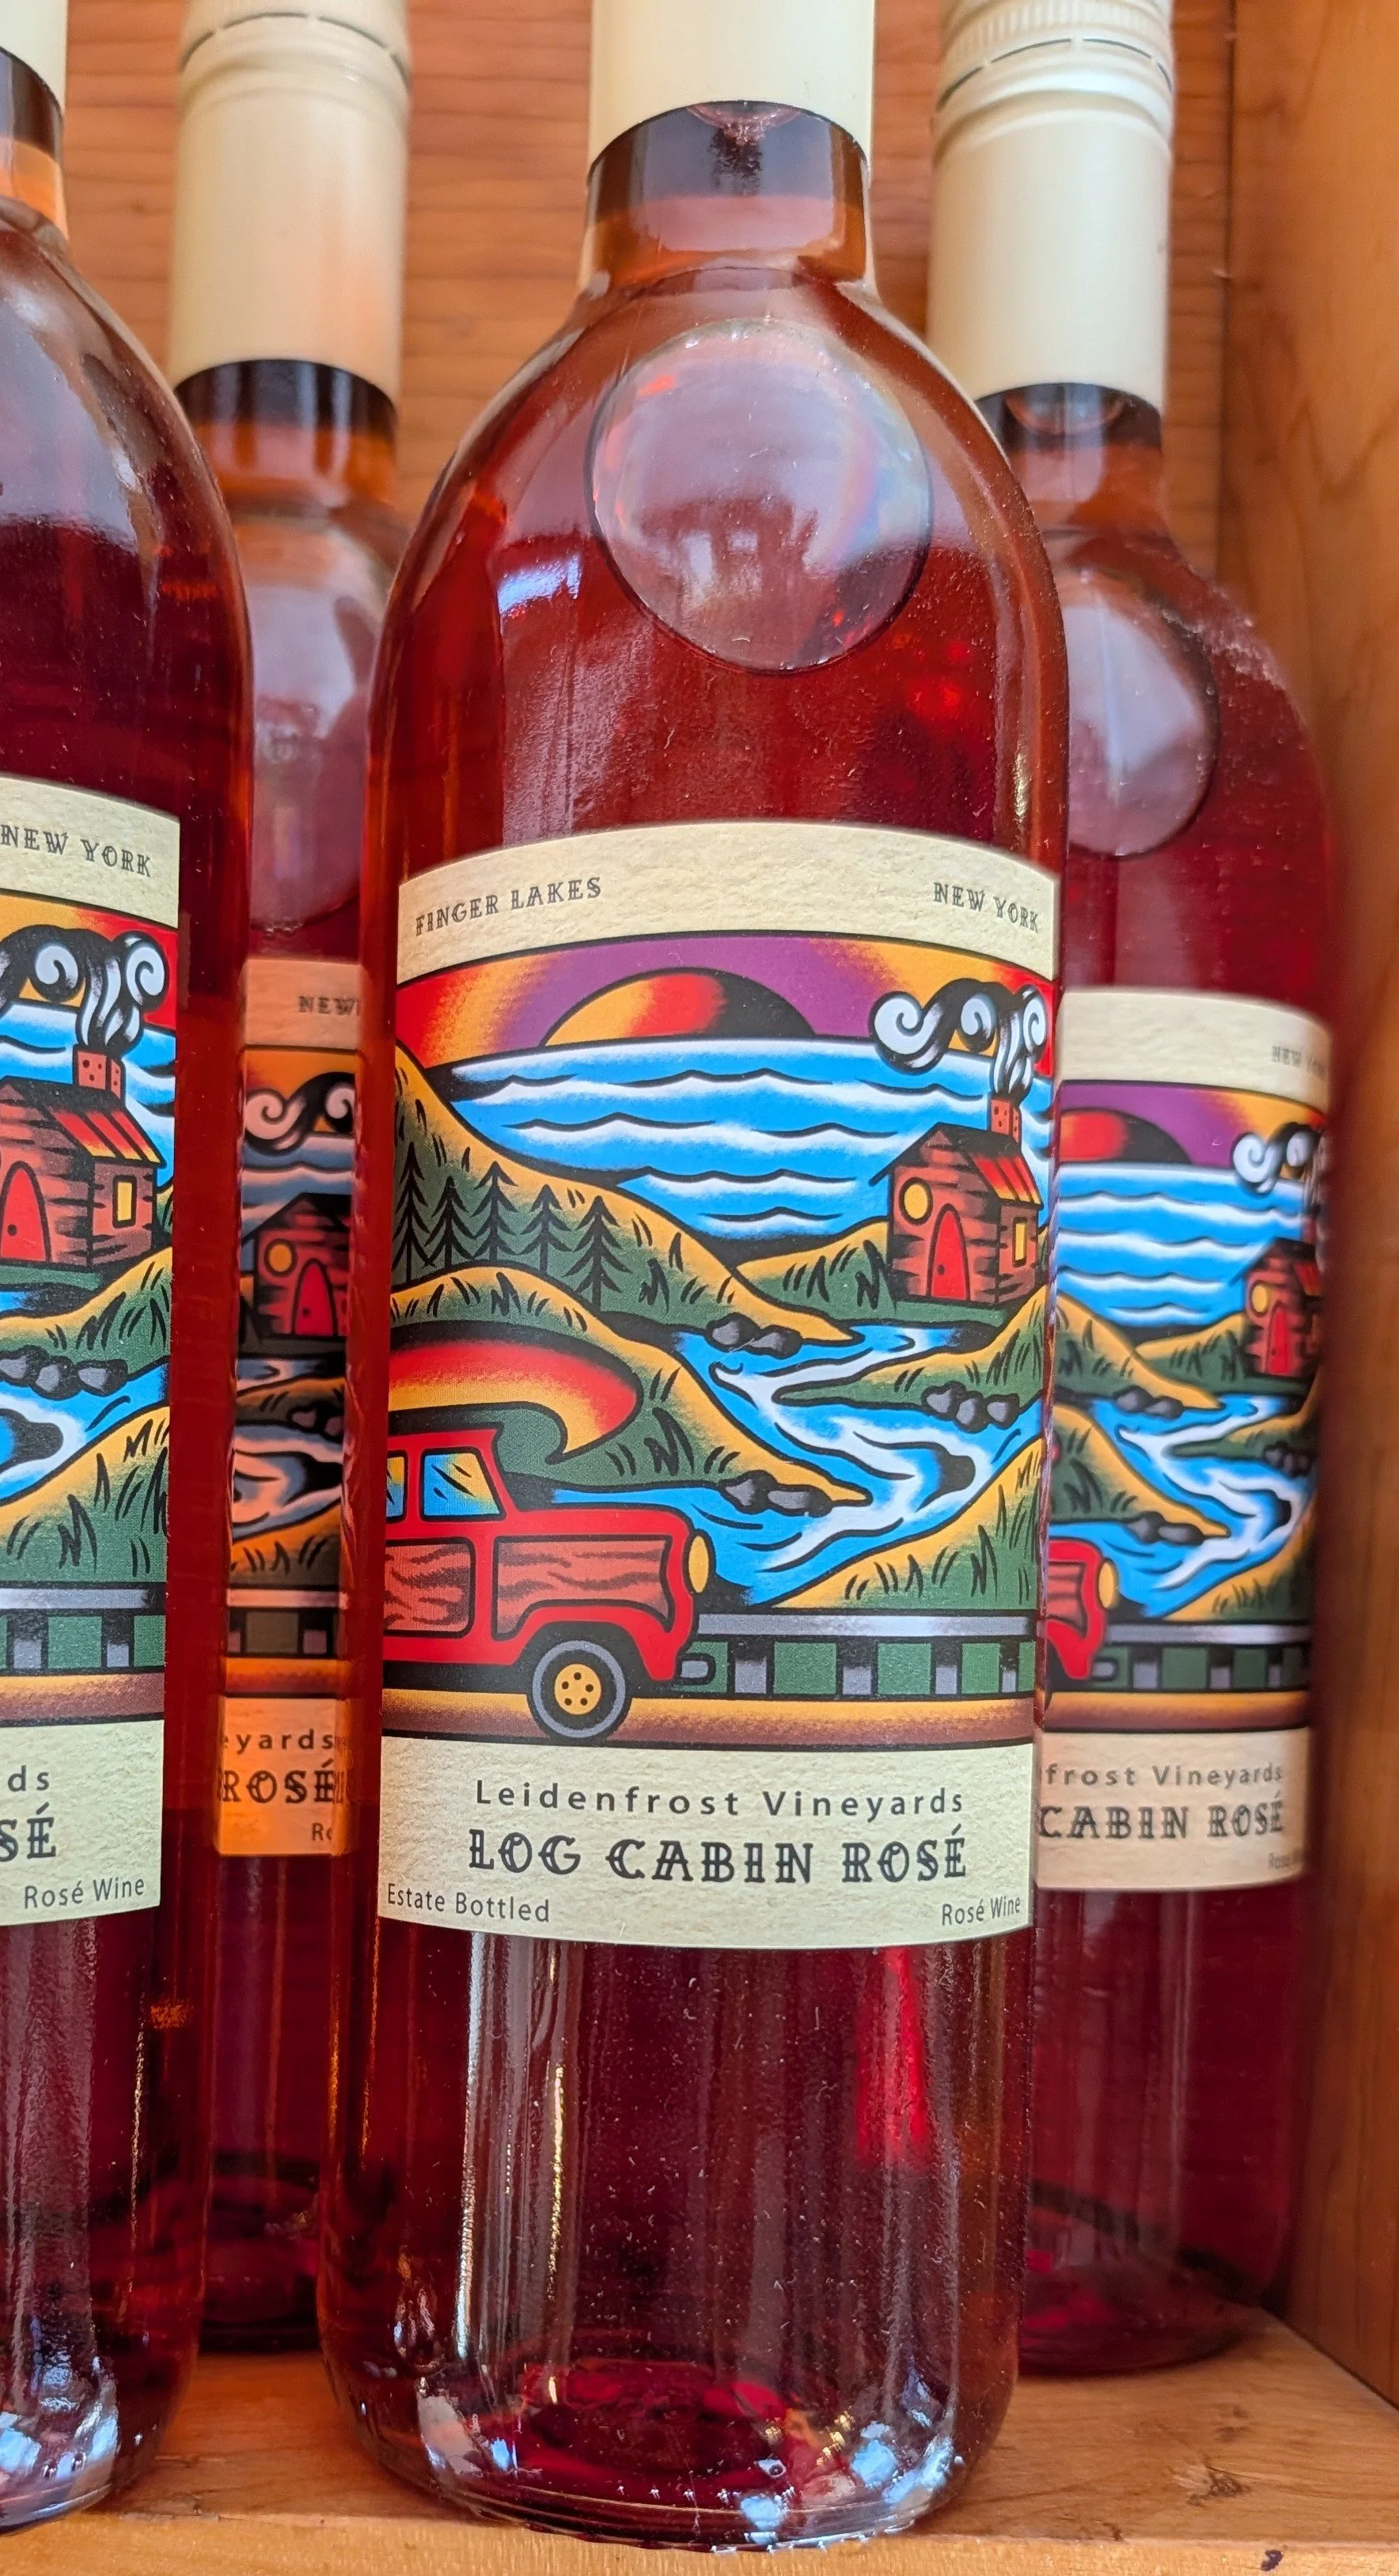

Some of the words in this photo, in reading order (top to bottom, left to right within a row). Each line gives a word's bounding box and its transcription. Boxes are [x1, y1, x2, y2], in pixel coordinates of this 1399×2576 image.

[0, 824, 69, 855] NEW
[80, 839, 151, 877] YORK
[415, 895, 499, 937] FINGER
[510, 877, 601, 911] LAKES
[934, 882, 985, 912] NEW
[993, 896, 1038, 934] YORK
[298, 995, 357, 1016] NEW
[222, 1758, 335, 1804] ROSÉ
[1152, 1762, 1283, 1790] Vineyards
[476, 1779, 738, 1816] Leidenfrost
[762, 1787, 962, 1822] Vineyards
[1039, 1805, 1189, 1839] CABIN
[1208, 1790, 1283, 1837] ROSÉ
[468, 1828, 582, 1875] LOG
[605, 1838, 813, 1883] CABIN
[841, 1823, 967, 1883] ROSÉ
[25, 1880, 84, 1909] Rosé
[93, 1877, 145, 1902] Wine
[388, 1882, 445, 1912] Estate
[455, 1892, 549, 1923] Bottled
[942, 1899, 984, 1926] Rosé
[990, 1896, 1021, 1919] Wine
